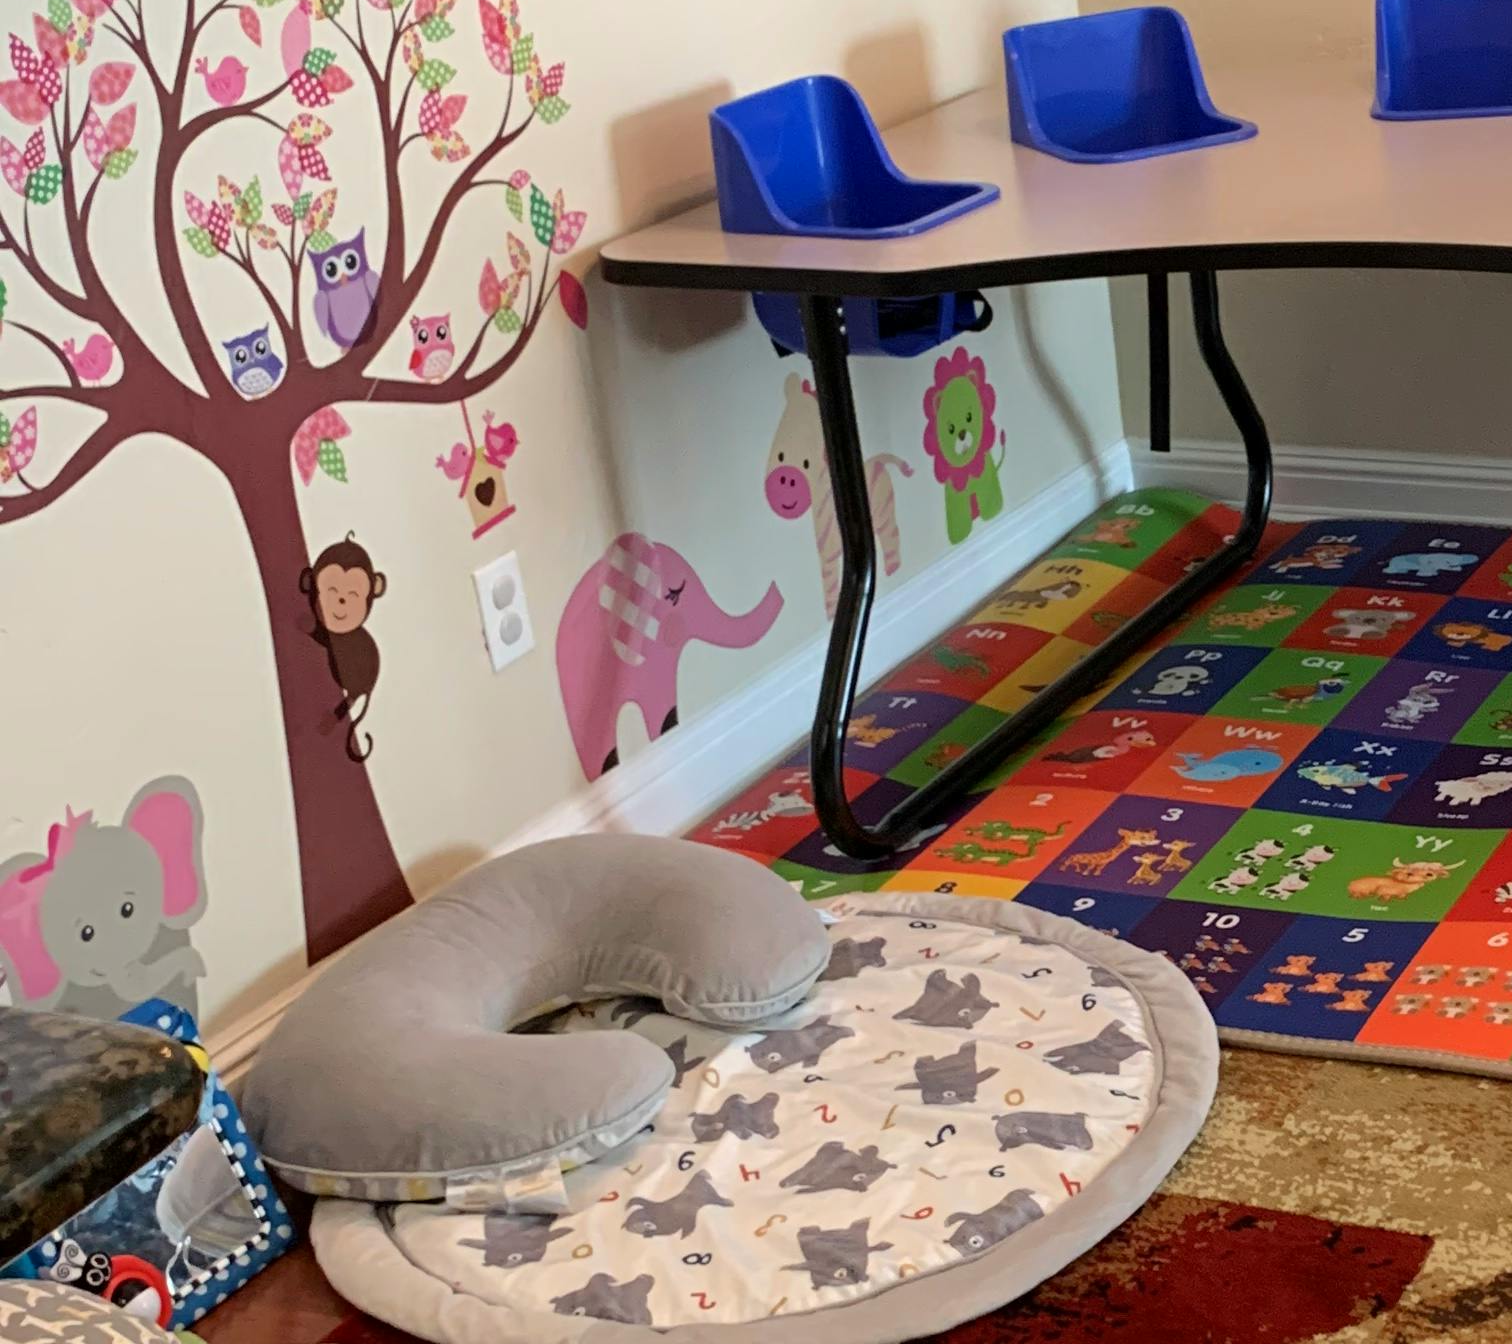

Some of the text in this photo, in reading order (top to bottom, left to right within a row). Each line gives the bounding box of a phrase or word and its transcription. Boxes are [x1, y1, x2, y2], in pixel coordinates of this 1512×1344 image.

[1115, 504, 1155, 517] Bb
[1316, 534, 1358, 545] Dd
[1427, 538, 1462, 549] Ee
[1044, 564, 1084, 576] Hh
[1261, 590, 1286, 602] Jj
[1366, 595, 1405, 608] Kk
[965, 627, 1008, 641] Nn
[1184, 649, 1223, 663] Pp
[1301, 656, 1346, 673] Qq
[1424, 669, 1461, 684] Rr
[888, 696, 918, 709] Tt
[1111, 716, 1148, 730] Vv
[1223, 724, 1283, 742] Ww
[1352, 740, 1399, 757] Xx
[1029, 792, 1055, 808] 2
[1160, 807, 1185, 823] 3
[1291, 823, 1315, 837] 4
[1414, 834, 1454, 853] Yy
[934, 881, 959, 894] 8
[1071, 897, 1097, 912] 9
[1201, 911, 1241, 930] 10
[1341, 927, 1370, 944] 5
[1486, 931, 1511, 948] 6
